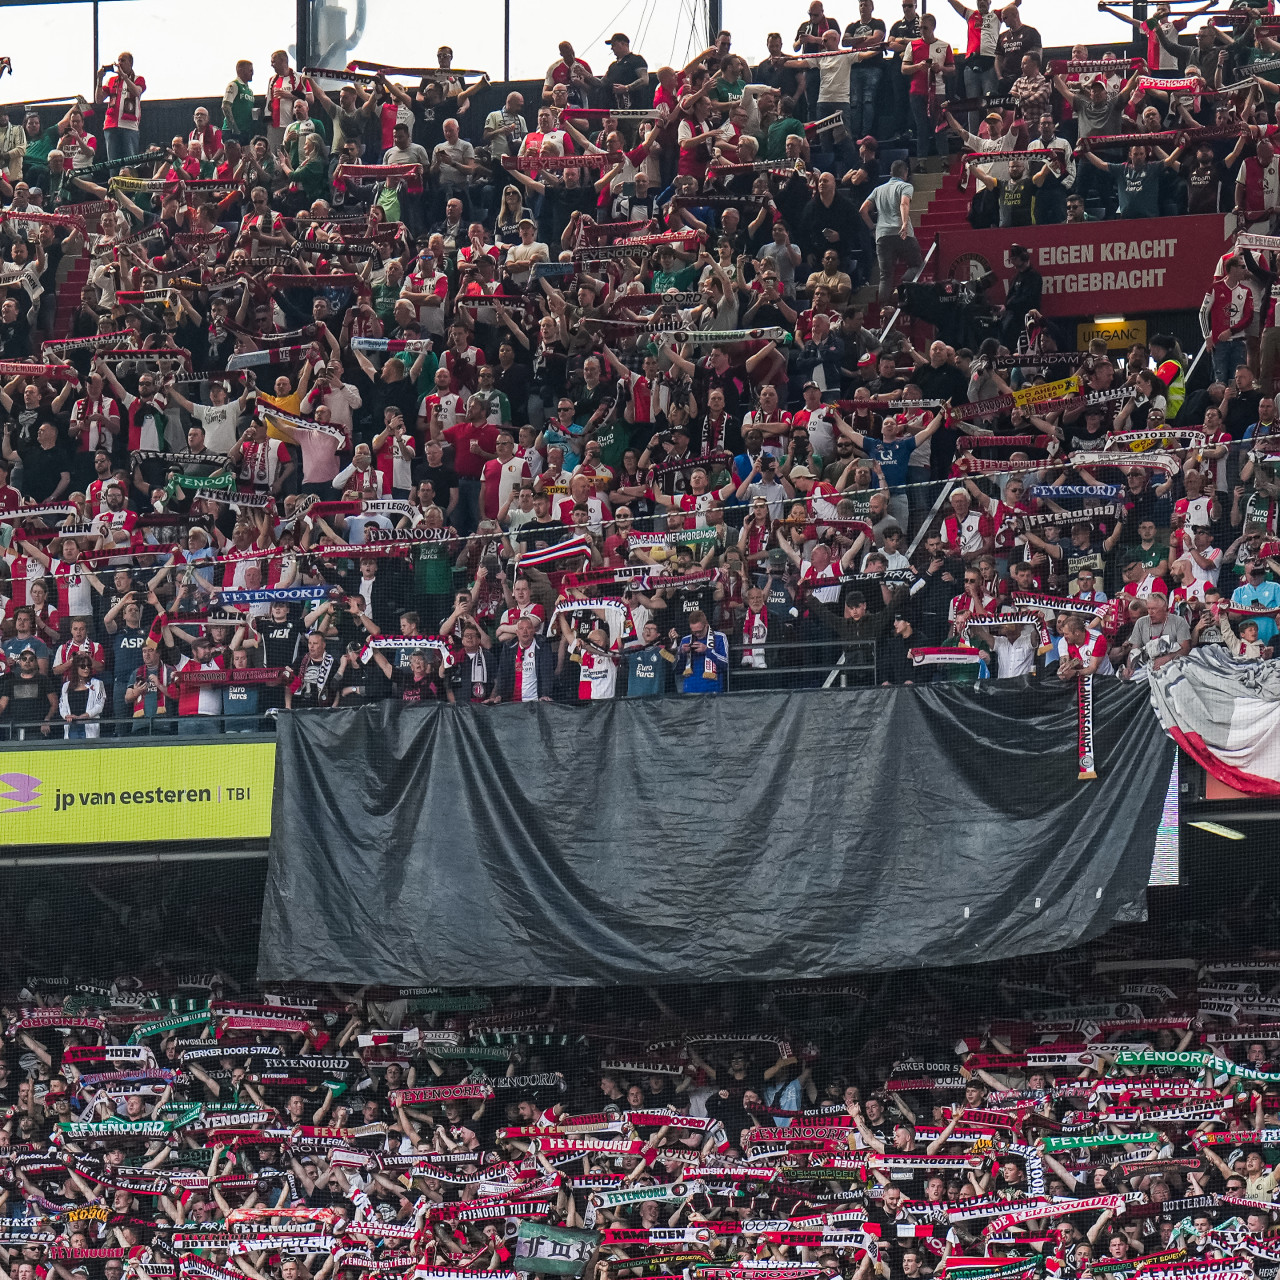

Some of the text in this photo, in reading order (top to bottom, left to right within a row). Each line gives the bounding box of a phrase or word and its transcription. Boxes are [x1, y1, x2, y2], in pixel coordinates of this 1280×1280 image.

[1038, 246, 1094, 266] EIGEN
[1104, 239, 1178, 263] KRACHT
[1004, 268, 1167, 296] RTGEBRACHT
[1032, 485, 1118, 496] FEYENOORD
[370, 501, 388, 509] HET
[1030, 505, 1117, 523] FEYENOORD
[370, 527, 451, 541] FEYENOORD
[223, 586, 325, 601] FEYENOORD
[54, 784, 251, 811] jp van eesteren TBI
[183, 1046, 281, 1060] STERKER DOOR STRIJD
[70, 1120, 171, 1134] FEYENOORD
[549, 1139, 633, 1151] FEYENOORD
[1049, 1133, 1152, 1147] FEYENOORD
[883, 1157, 965, 1169] FEYENOORD
[683, 1167, 774, 1180] LANDSKAMPIOEN
[607, 1187, 673, 1203] FEYENOORD
[457, 1206, 507, 1219] FEYENOORD
[509, 1203, 526, 1216] TILL
[533, 1201, 550, 1214] DIE
